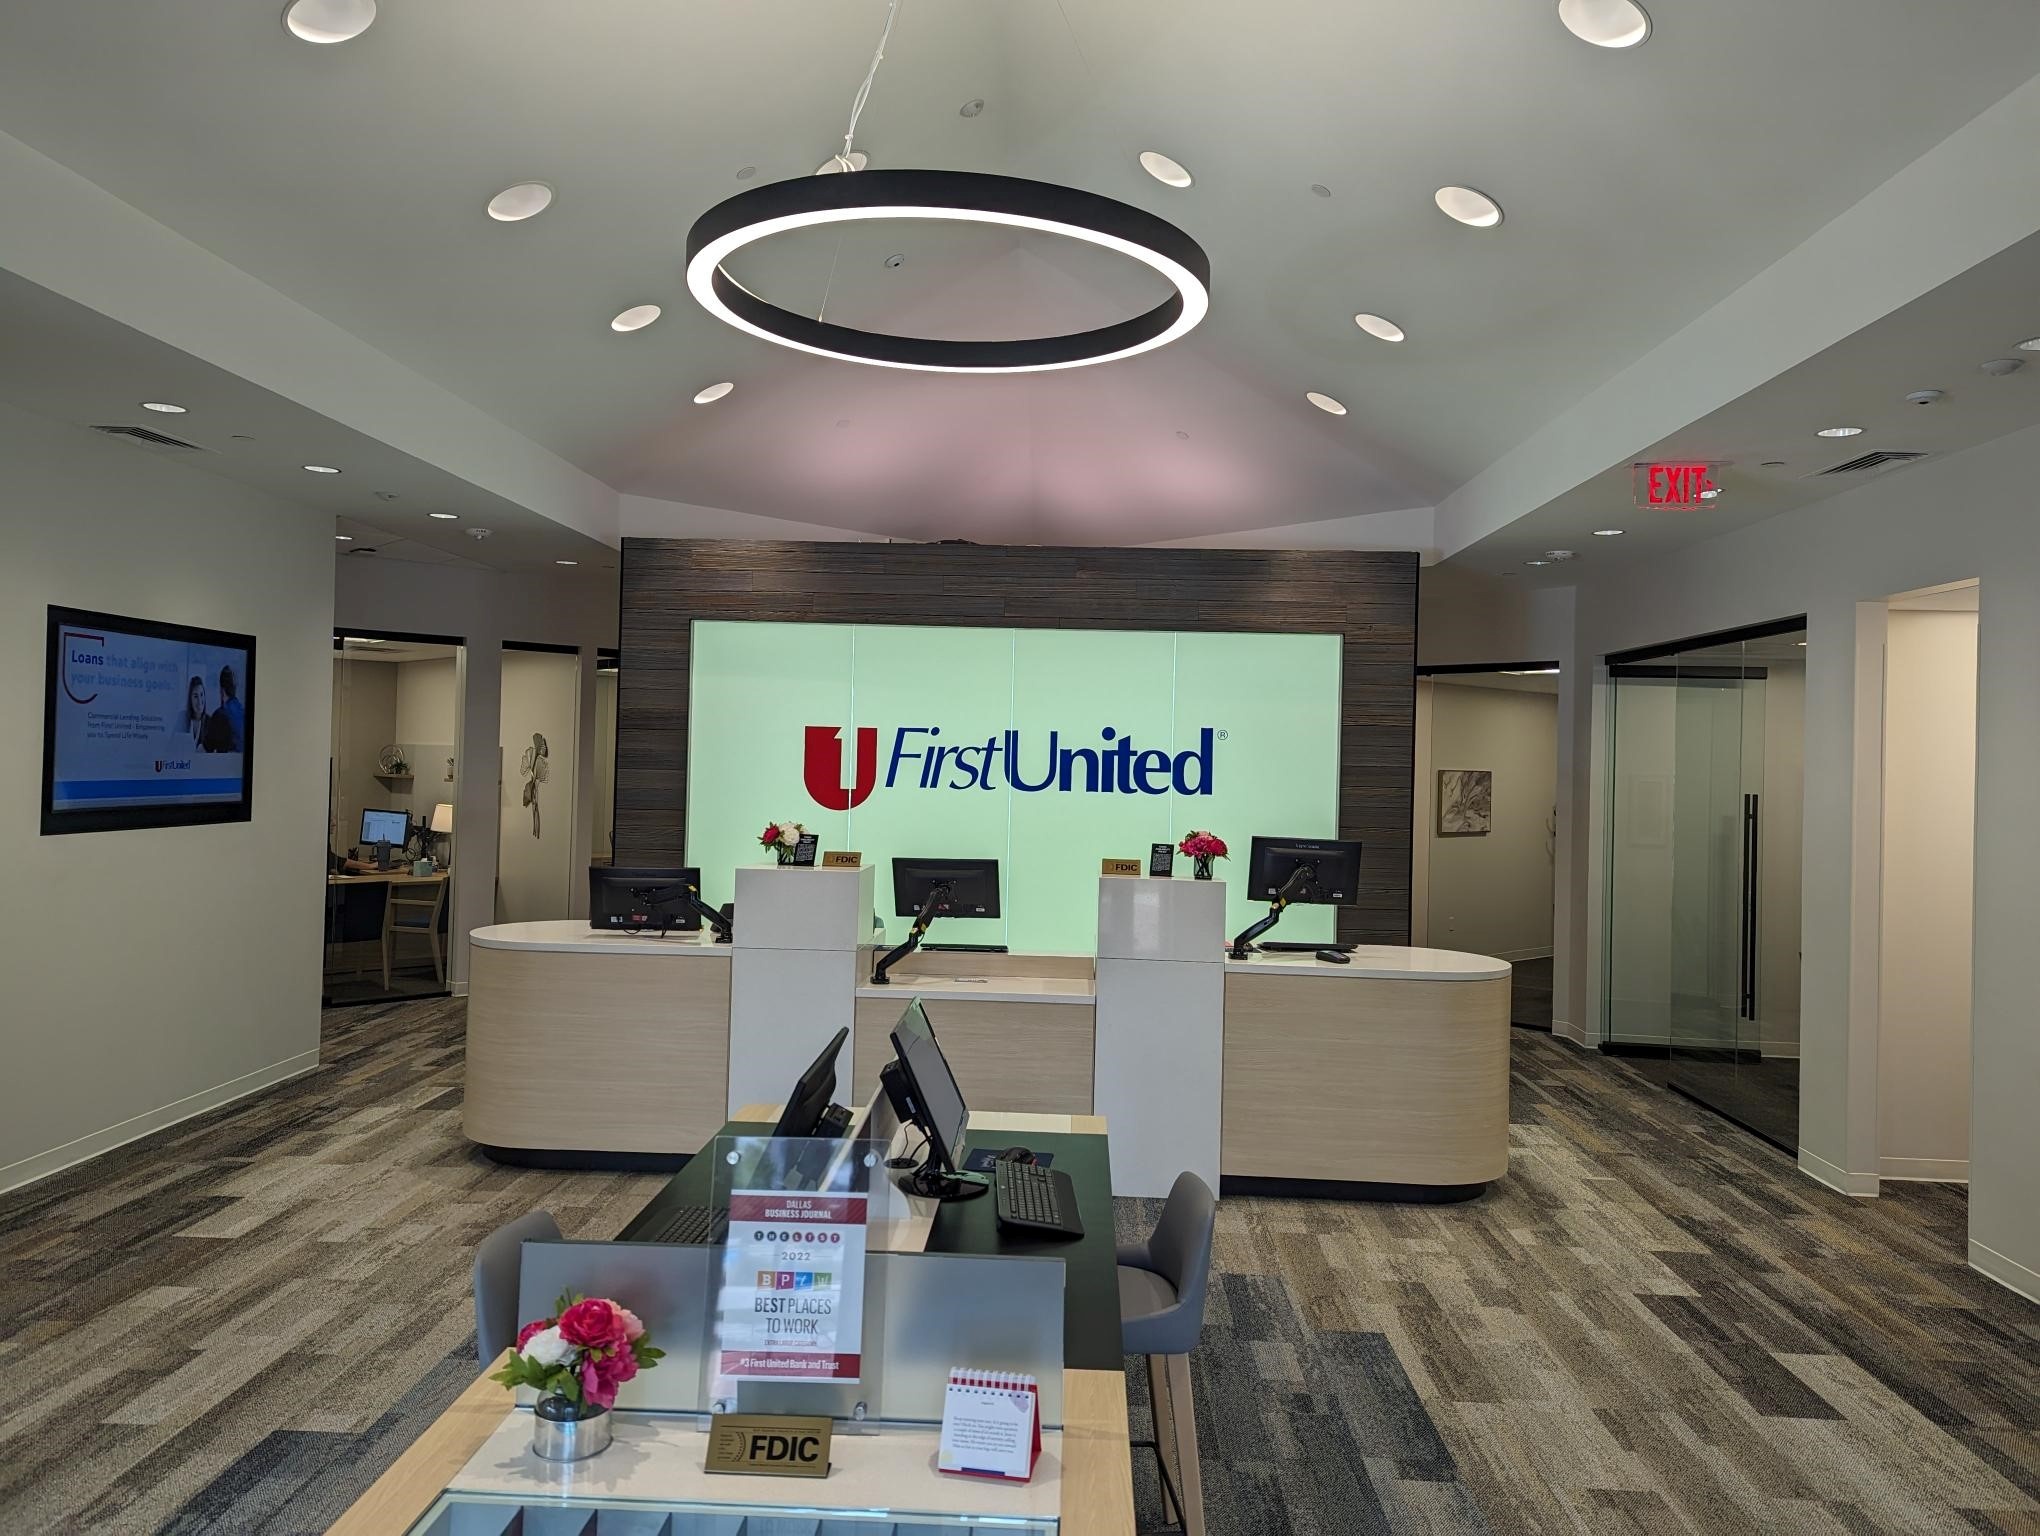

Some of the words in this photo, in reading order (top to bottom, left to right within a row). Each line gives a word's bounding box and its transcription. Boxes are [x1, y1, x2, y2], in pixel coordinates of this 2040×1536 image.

[1649, 466, 1708, 504] EXIT
[71, 650, 104, 665] Loans
[106, 654, 128, 668] that
[130, 656, 156, 674] align
[70, 673, 96, 688] your
[97, 672, 144, 689] business
[835, 855, 858, 864] FDIC
[1115, 863, 1138, 872] FDIC
[786, 1200, 812, 1209] DALLAS
[765, 1208, 800, 1218] BUSINESS
[801, 1210, 832, 1219] JOURNAL
[781, 1251, 811, 1261] 2022
[754, 1297, 786, 1314] BEST
[787, 1298, 832, 1315] PLACES
[766, 1317, 781, 1334] TO
[783, 1318, 819, 1335] WORK
[750, 1358, 766, 1368] First
[766, 1359, 790, 1368] United
[790, 1360, 807, 1369] Bank
[807, 1360, 821, 1369] and
[821, 1361, 840, 1370] Trust
[749, 1435, 820, 1463] FDIC
